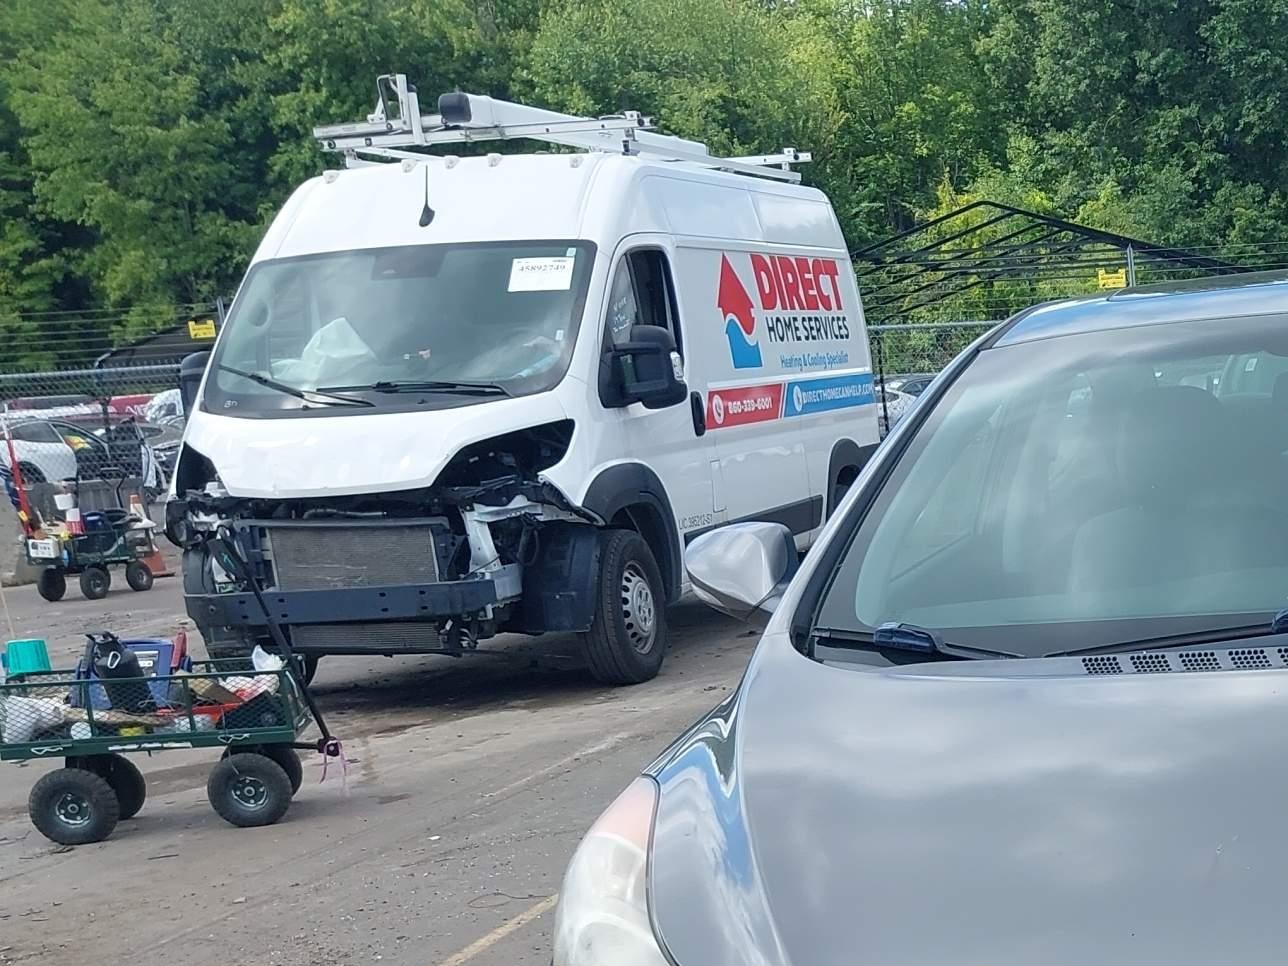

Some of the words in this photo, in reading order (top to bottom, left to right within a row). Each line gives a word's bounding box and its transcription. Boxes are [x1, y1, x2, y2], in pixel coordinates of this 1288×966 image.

[750, 253, 843, 311] DIRECT
[765, 317, 802, 342] HOME
[802, 316, 850, 341] SERVICES
[780, 355, 803, 371] Heating
[808, 353, 827, 370] Cooling
[802, 384, 873, 404] DIRECTHOMECANHELP.COM
